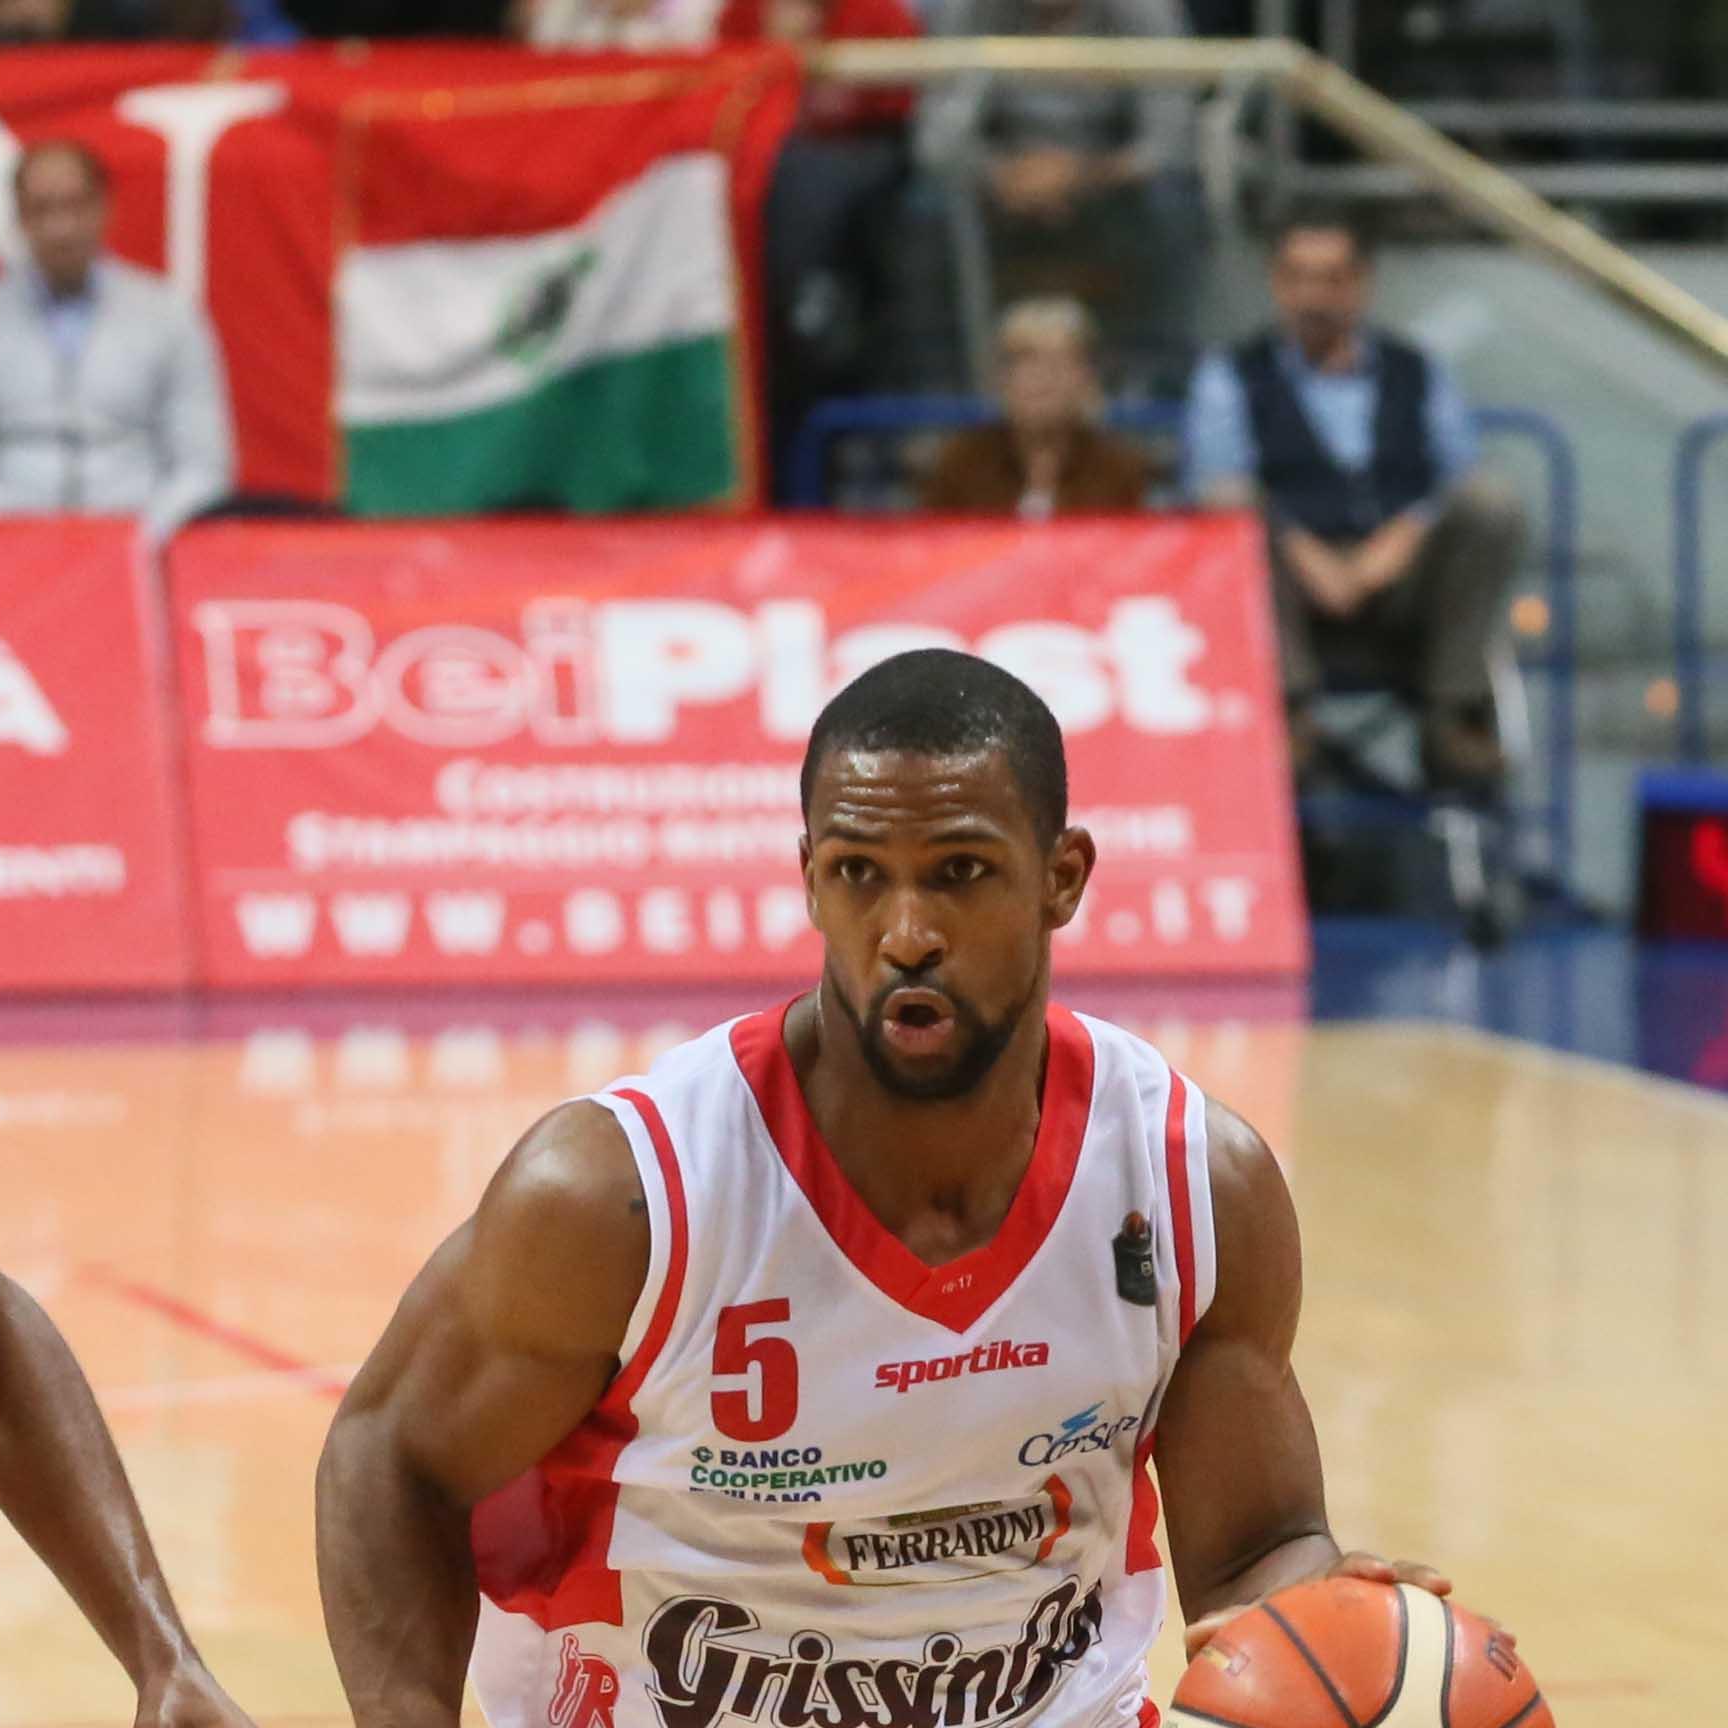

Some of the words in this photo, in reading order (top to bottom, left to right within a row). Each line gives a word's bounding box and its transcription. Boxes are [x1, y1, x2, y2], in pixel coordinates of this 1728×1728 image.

[710, 1298, 799, 1442] 5
[874, 1339, 1049, 1393] sportika
[690, 1459, 888, 1490] COOPERATIVO
[720, 1447, 823, 1469] BANCO
[842, 1504, 1047, 1571] FERRARINI
